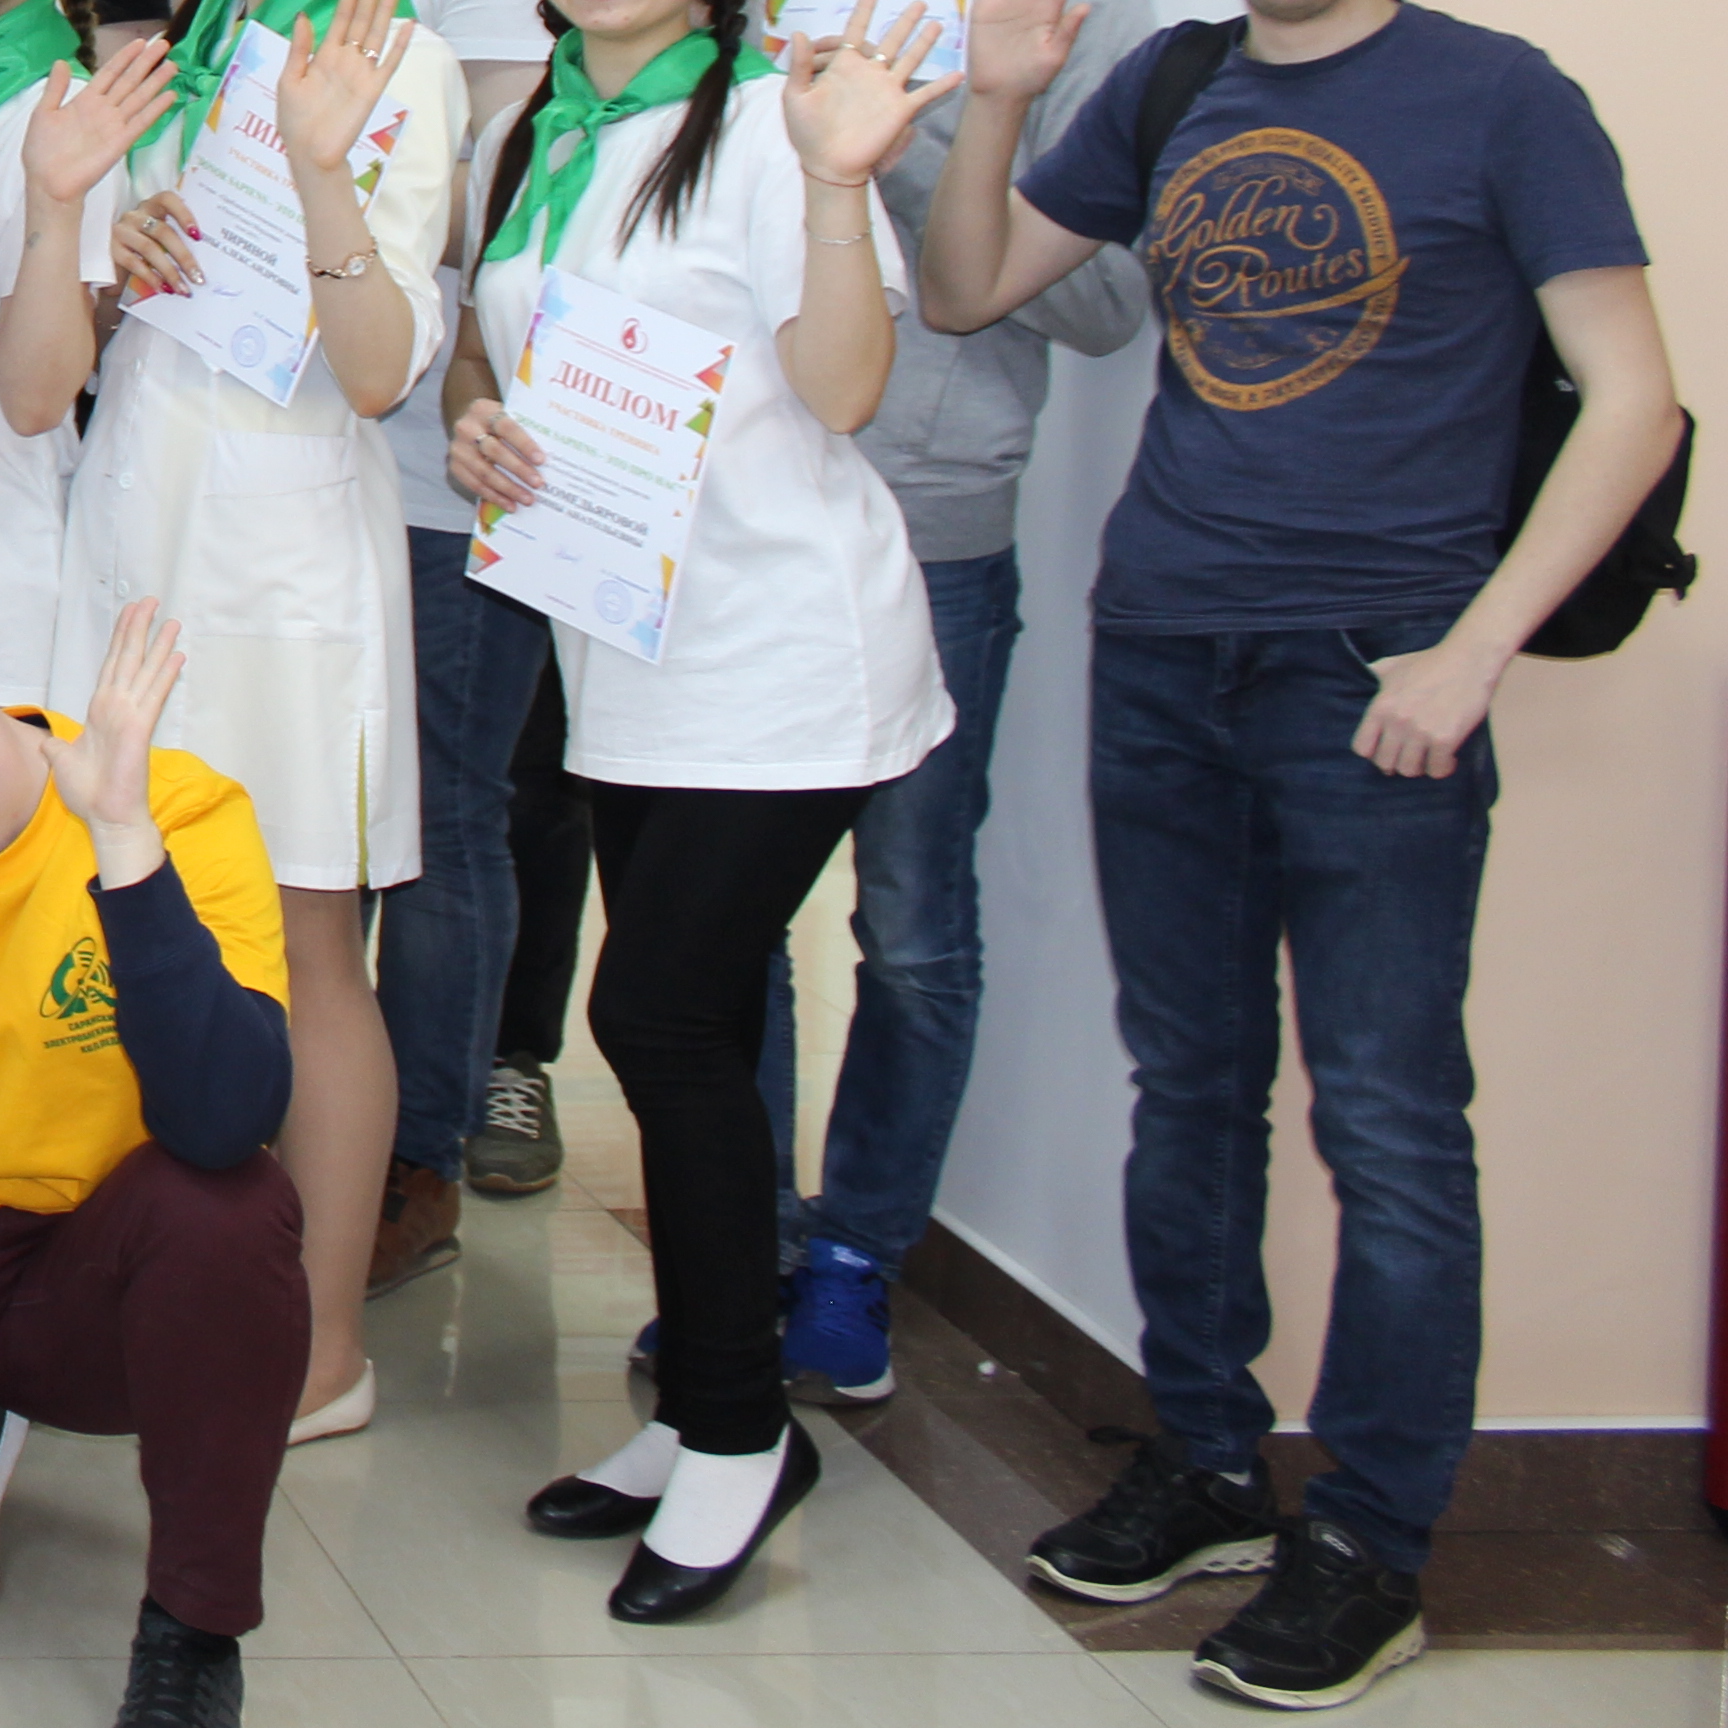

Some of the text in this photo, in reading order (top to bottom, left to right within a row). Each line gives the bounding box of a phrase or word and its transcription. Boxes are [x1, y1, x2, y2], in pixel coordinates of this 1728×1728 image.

[235, 110, 290, 153] ДИП
[1149, 175, 1340, 296] Golden
[1188, 244, 1365, 308] Routes
[550, 359, 679, 430] ДИПЛОМ
